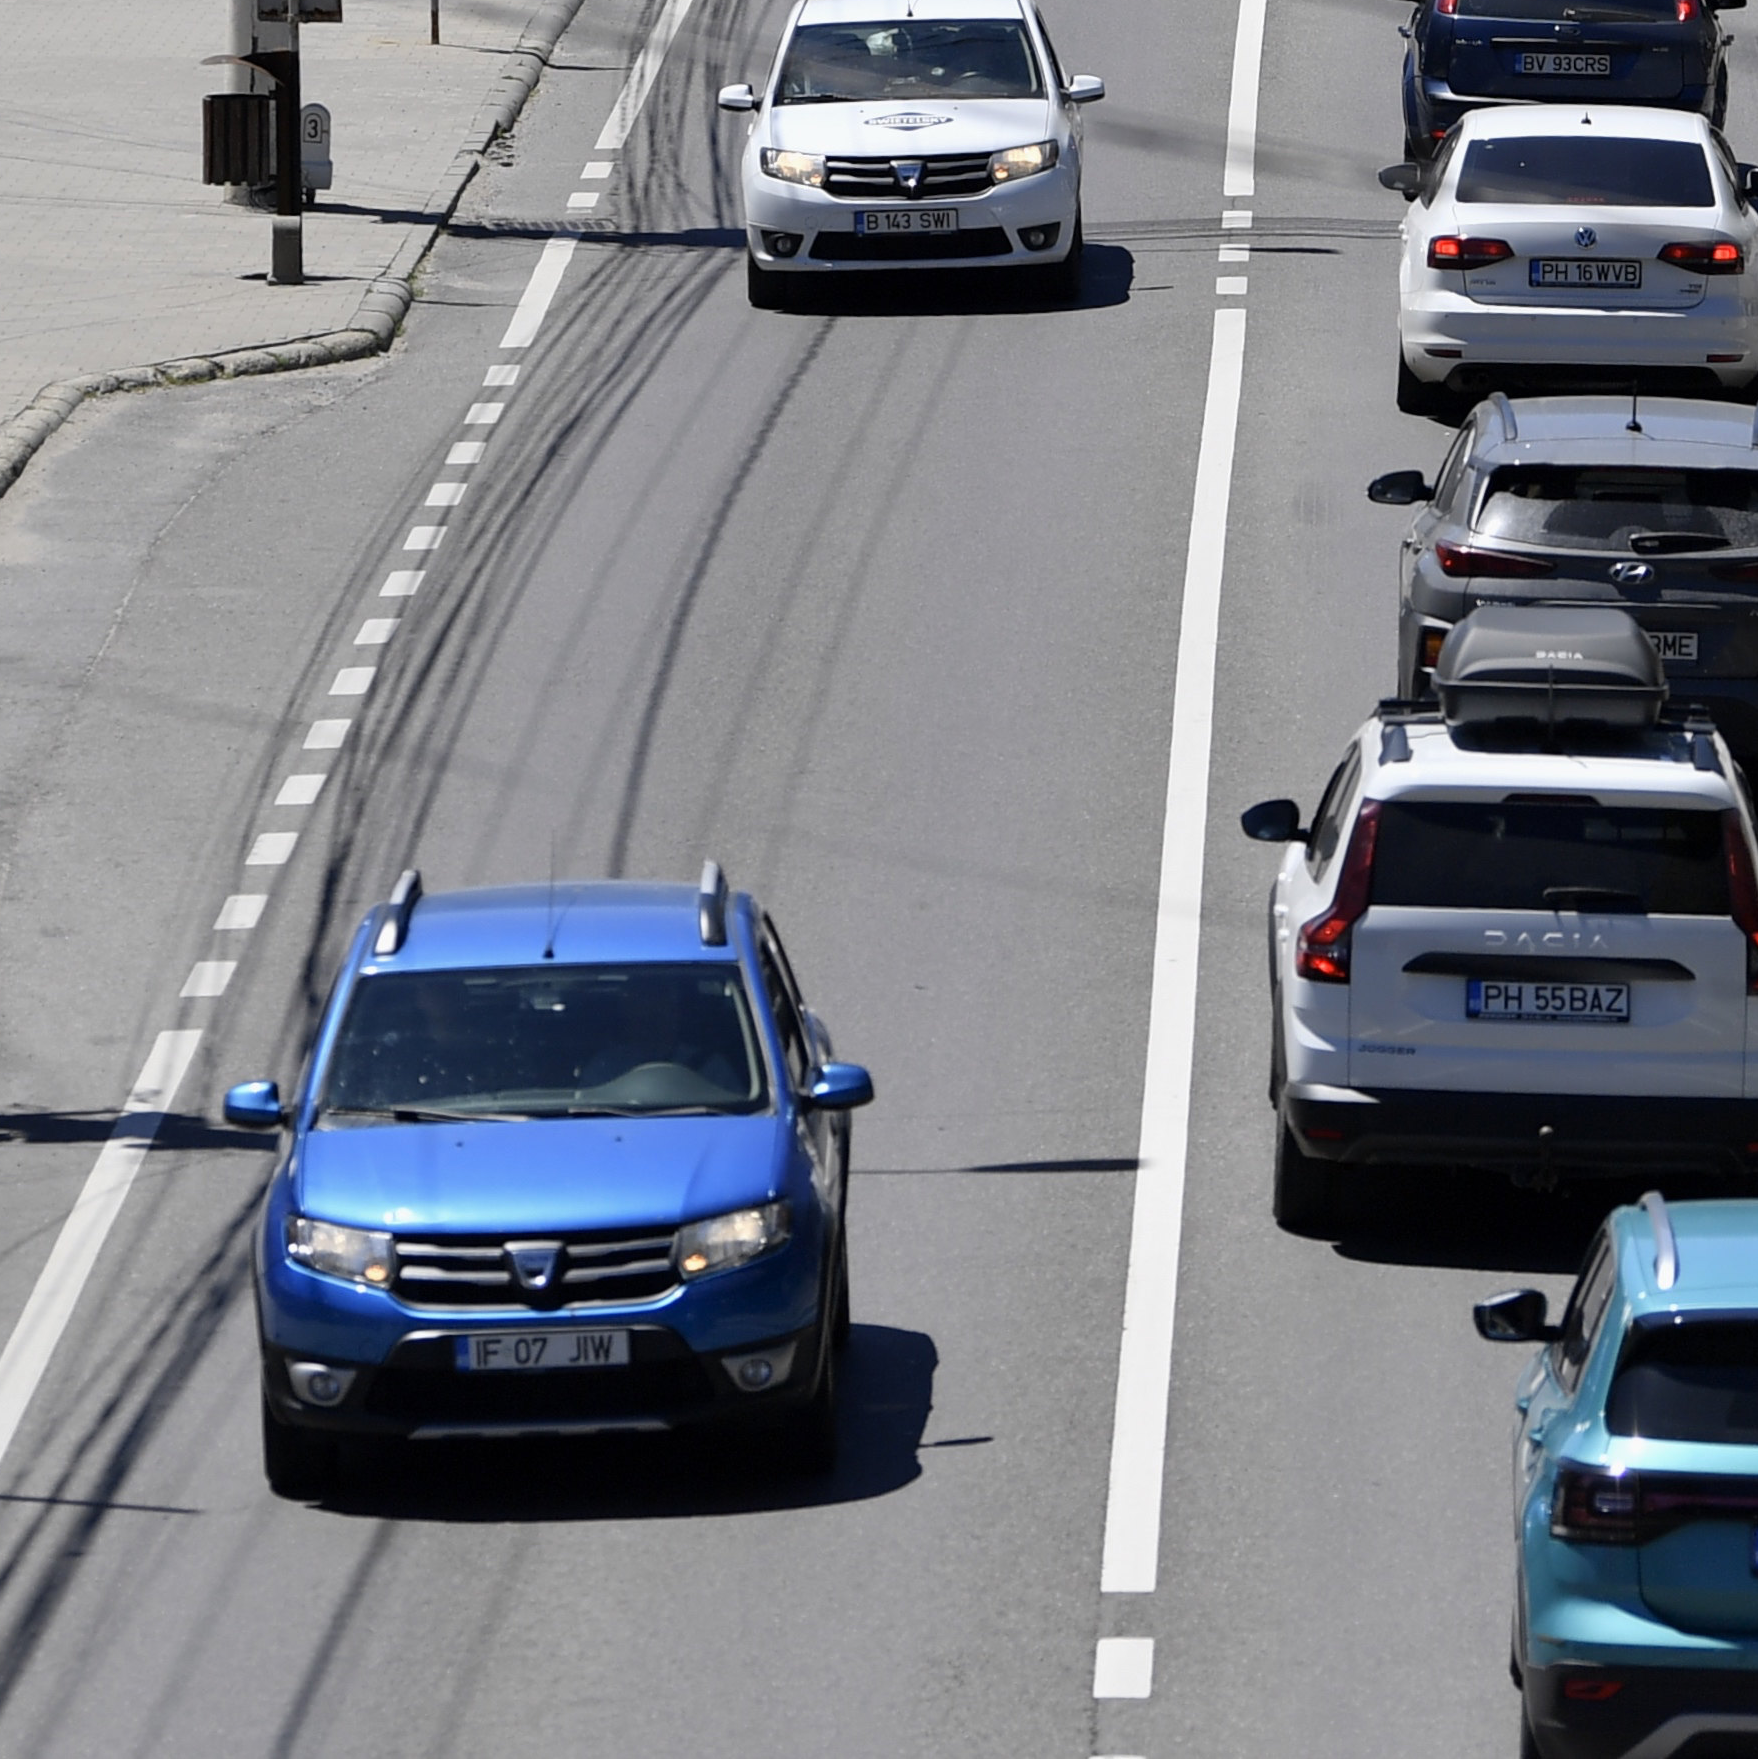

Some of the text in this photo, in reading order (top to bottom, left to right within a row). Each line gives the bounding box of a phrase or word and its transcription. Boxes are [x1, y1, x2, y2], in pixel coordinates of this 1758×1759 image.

[1523, 55, 1545, 71] BV
[308, 119, 318, 139] 3
[866, 214, 950, 229] B 143 SWI
[1541, 264, 1568, 281] PH
[1535, 650, 1584, 660] DACIA
[1484, 930, 1608, 952] DACIA
[1484, 984, 1523, 1011] PH
[1357, 1045, 1416, 1057] JOGGER
[476, 1335, 615, 1366] IF 07 JIW
